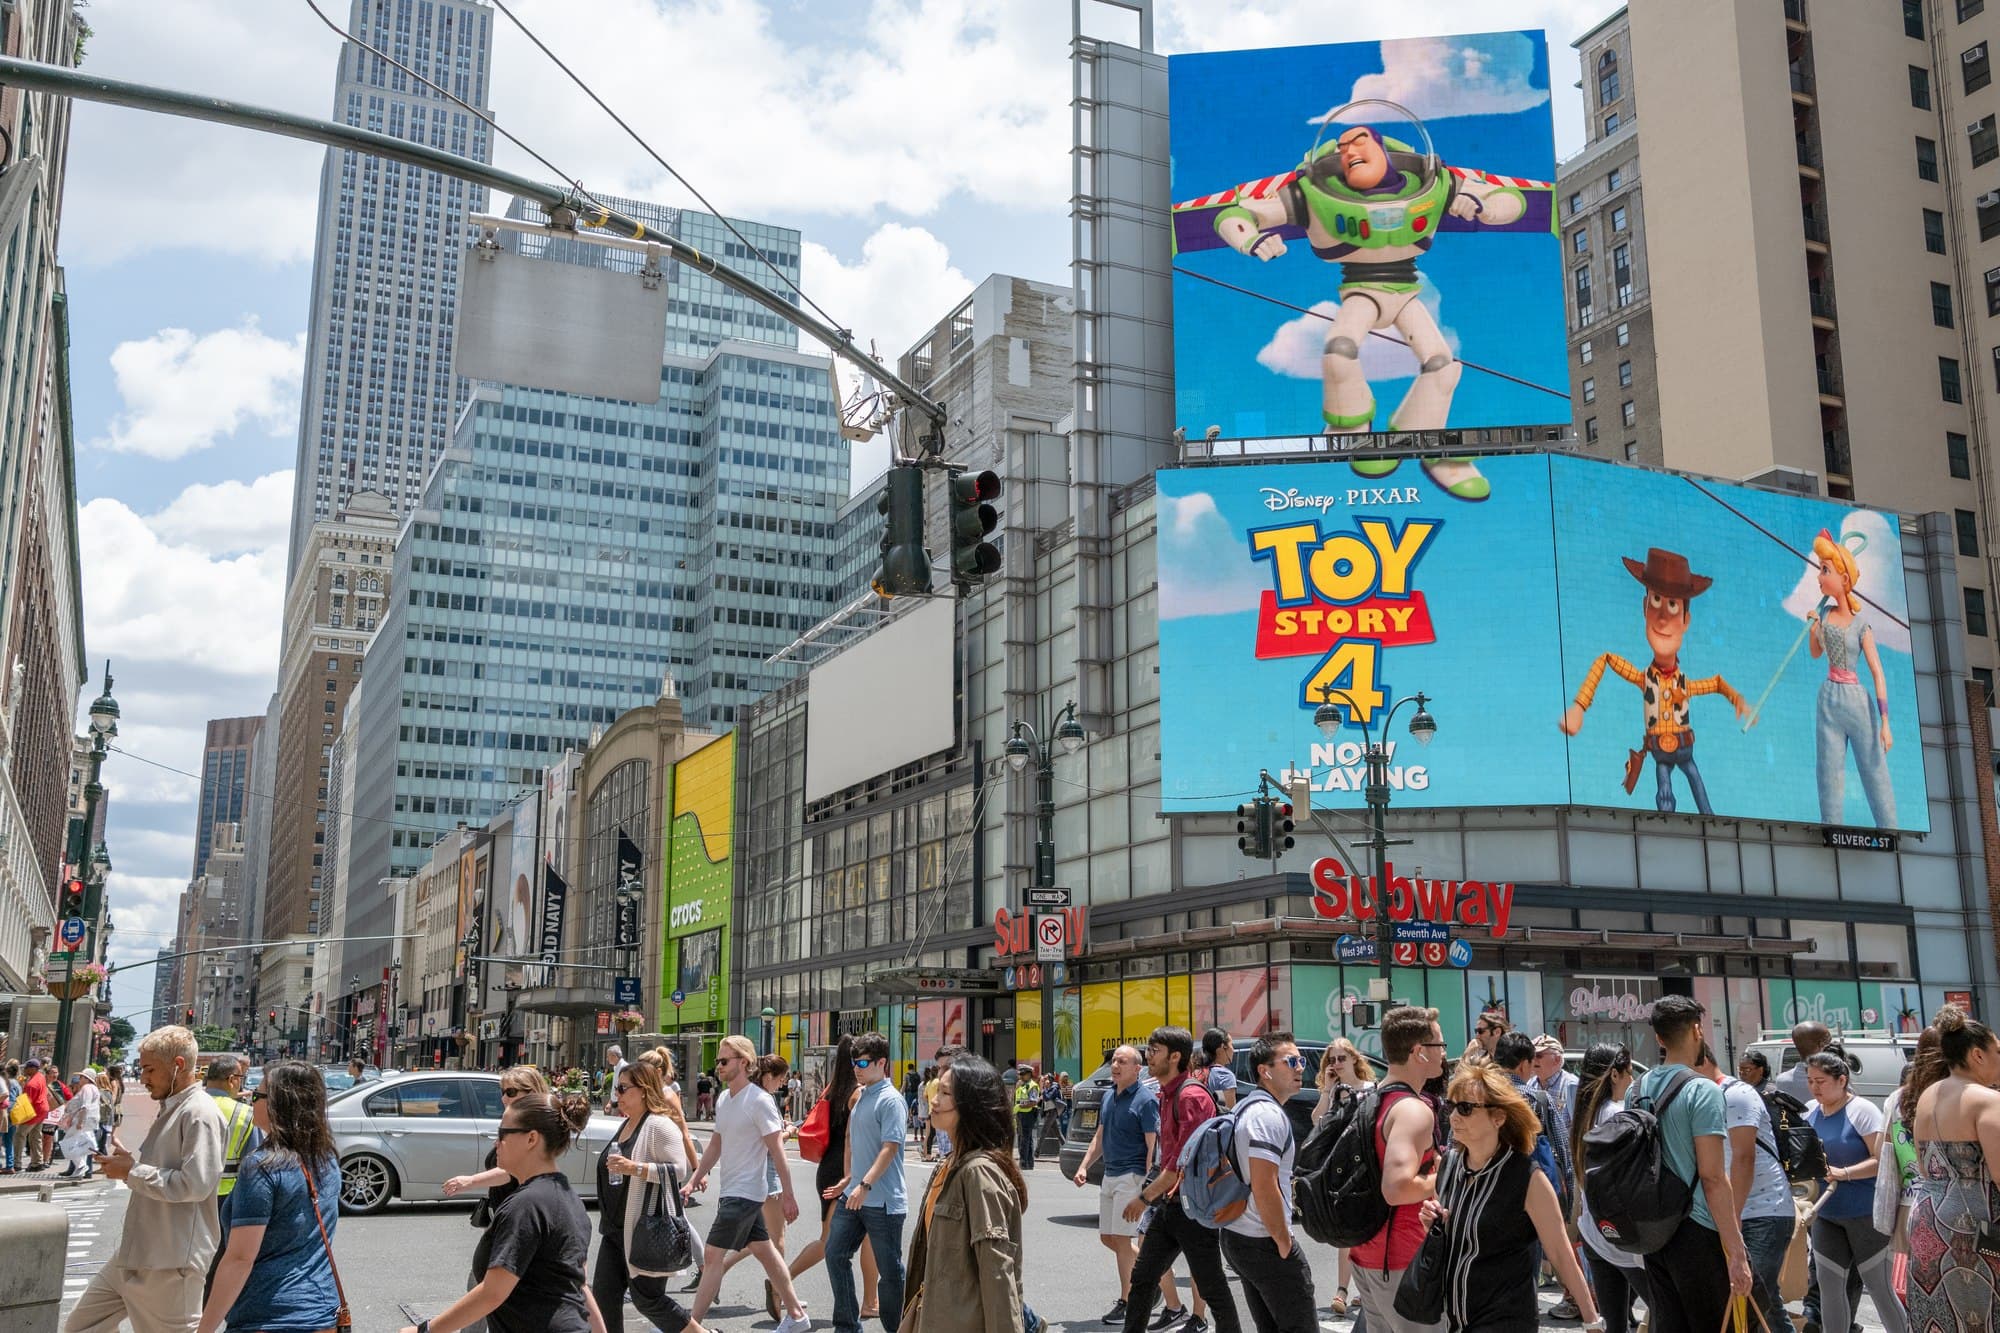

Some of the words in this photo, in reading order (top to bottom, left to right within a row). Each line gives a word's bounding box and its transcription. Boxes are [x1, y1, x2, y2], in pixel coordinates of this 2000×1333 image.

[1259, 487, 1334, 514] Disney
[1346, 487, 1421, 505] PIXAR
[1247, 515, 1445, 608] TOY
[1274, 607, 1416, 636] STORY
[1299, 637, 1391, 730] 4
[1832, 833, 1890, 848] SILVERCAST
[1309, 857, 1515, 938] Subway
[545, 892, 561, 932] NAVY
[671, 899, 703, 928] crocs
[1397, 927, 1429, 939] Seventh
[1431, 929, 1447, 939] Ave
[1341, 946, 1355, 958] West
[1367, 944, 1374, 955] St
[1400, 943, 1412, 961] 2
[1429, 943, 1440, 961] 3
[1449, 940, 1468, 962] MTA
